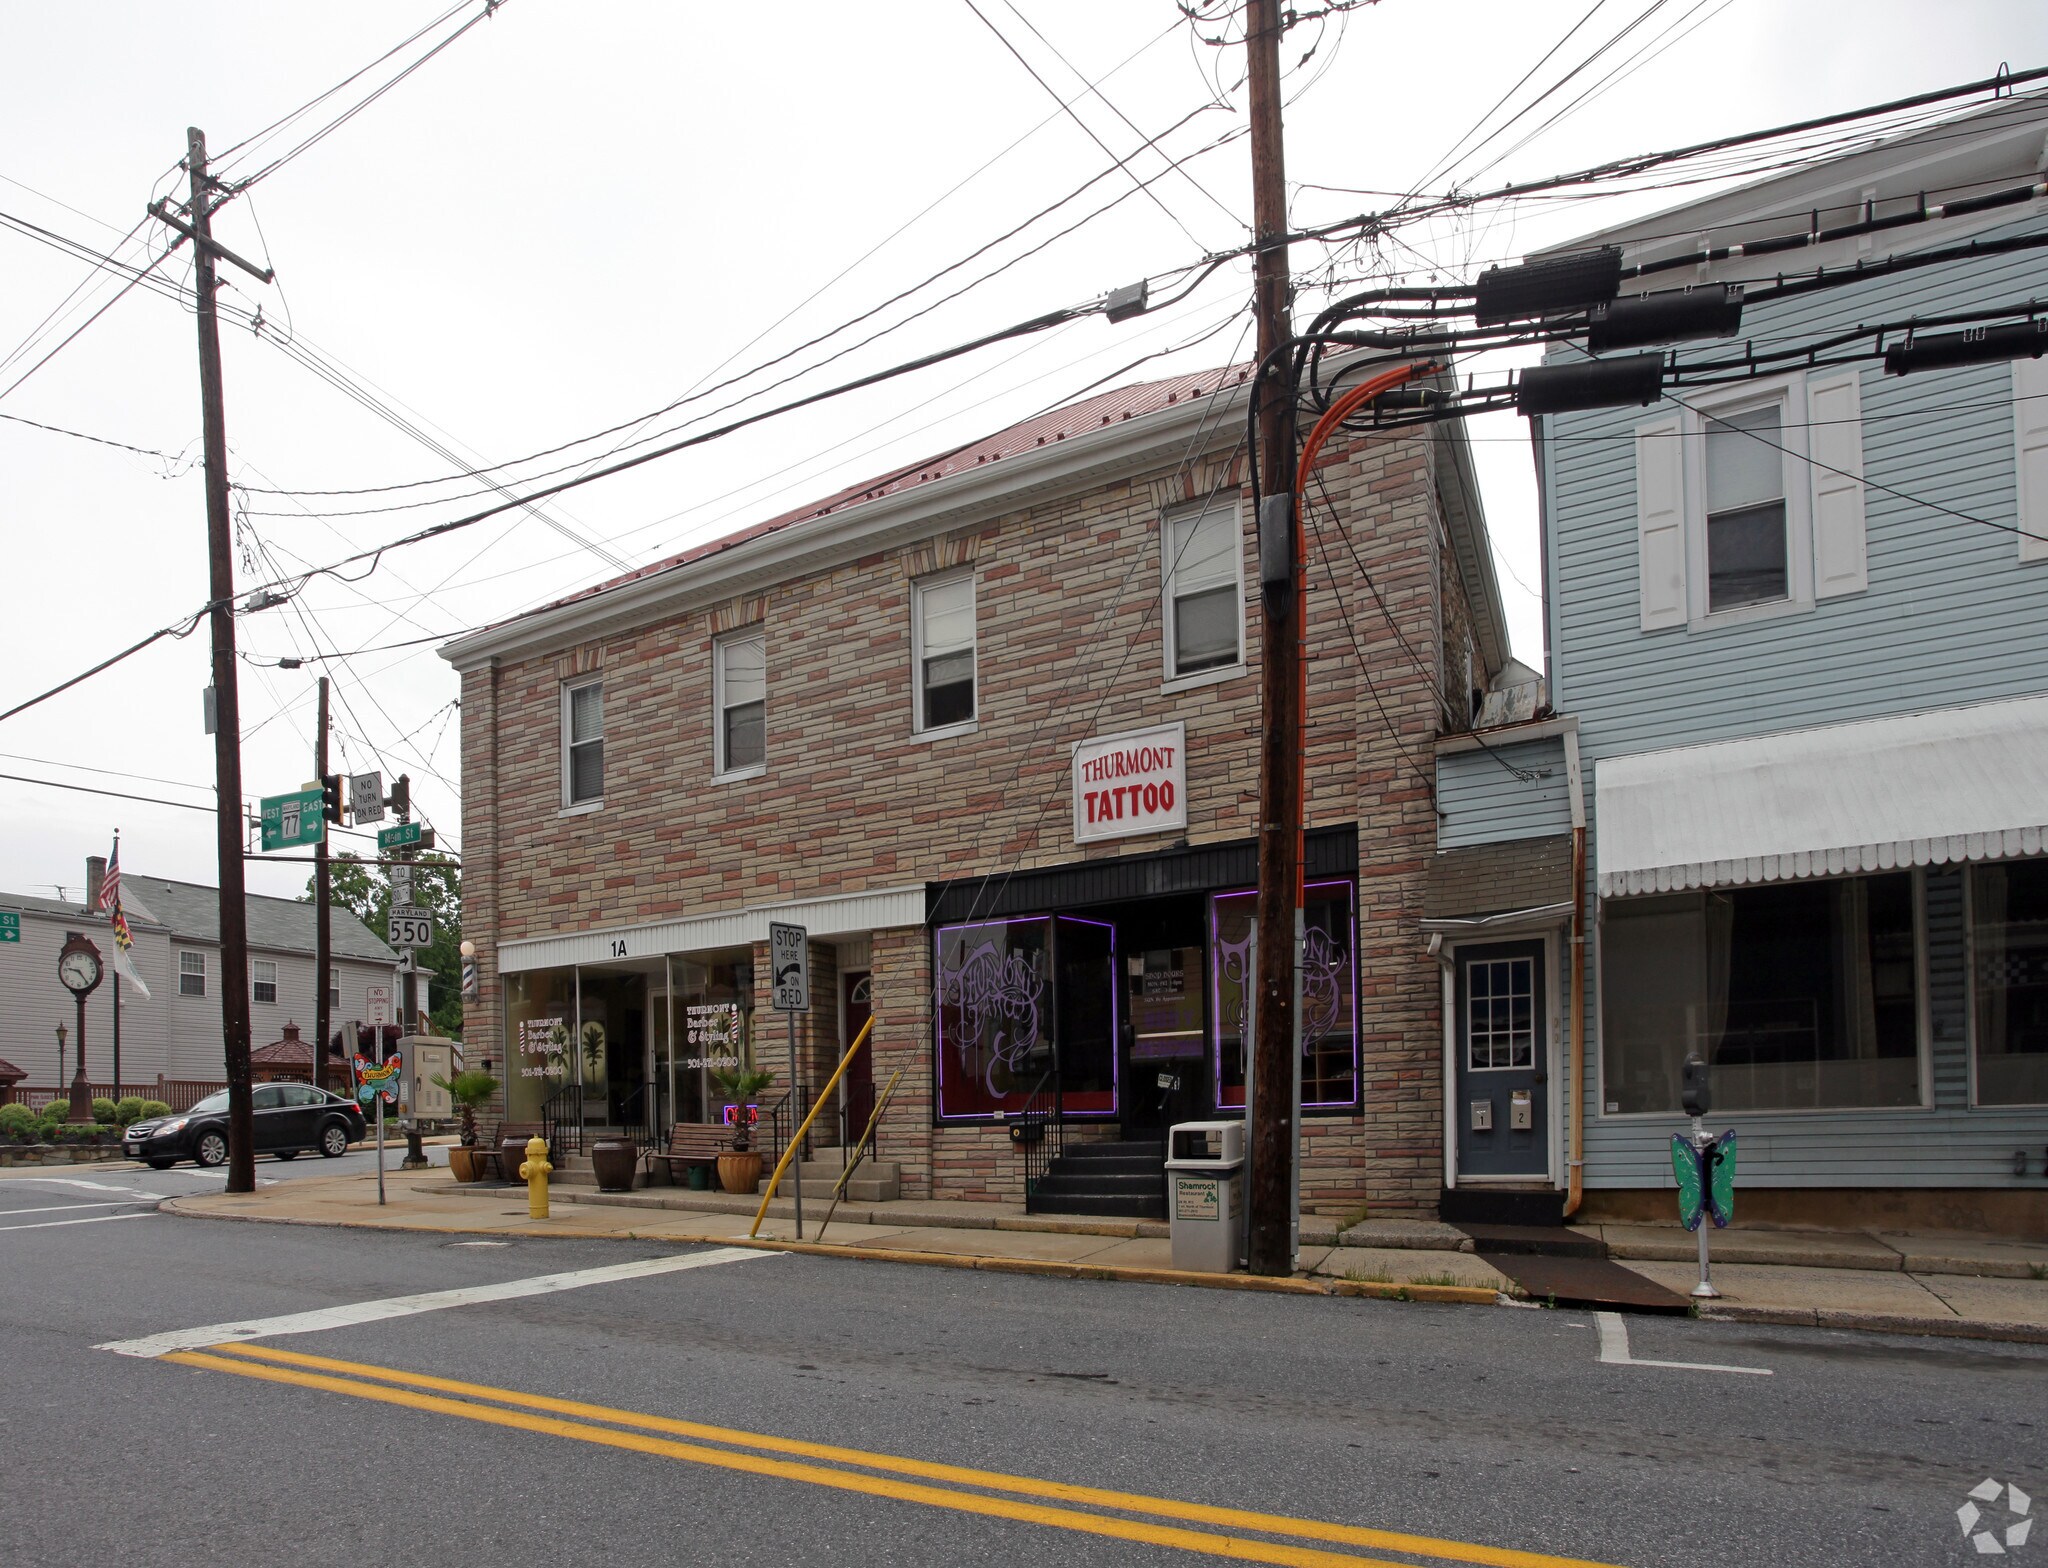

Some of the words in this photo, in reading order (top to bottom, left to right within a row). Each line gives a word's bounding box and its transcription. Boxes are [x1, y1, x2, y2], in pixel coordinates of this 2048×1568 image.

[1082, 747, 1175, 783] THURMONT
[361, 780, 372, 790] NO
[359, 793, 377, 804] TURN
[1084, 779, 1174, 823] TATTOO
[262, 807, 280, 819] WEST
[303, 800, 322, 813] EAST
[357, 808, 367, 818] ON
[368, 805, 382, 815] RED
[284, 814, 299, 835] 77
[384, 832, 401, 844] Main
[405, 827, 414, 839] St
[397, 867, 405, 878] TO
[2, 915, 15, 925] St
[391, 921, 429, 943] 550
[776, 929, 802, 948] STOP
[611, 940, 627, 957] 1A
[781, 950, 799, 961] HERE
[790, 976, 800, 987] ON
[781, 988, 802, 1005] RED
[687, 1003, 730, 1015] THURMONT
[527, 1018, 563, 1028] THURMONT
[687, 1016, 719, 1029] Barber
[698, 1030, 730, 1045] Styling
[364, 1063, 393, 1079] THURMONT
[1518, 1112, 1524, 1123] 2
[1178, 1181, 1216, 1190] Shamrock
